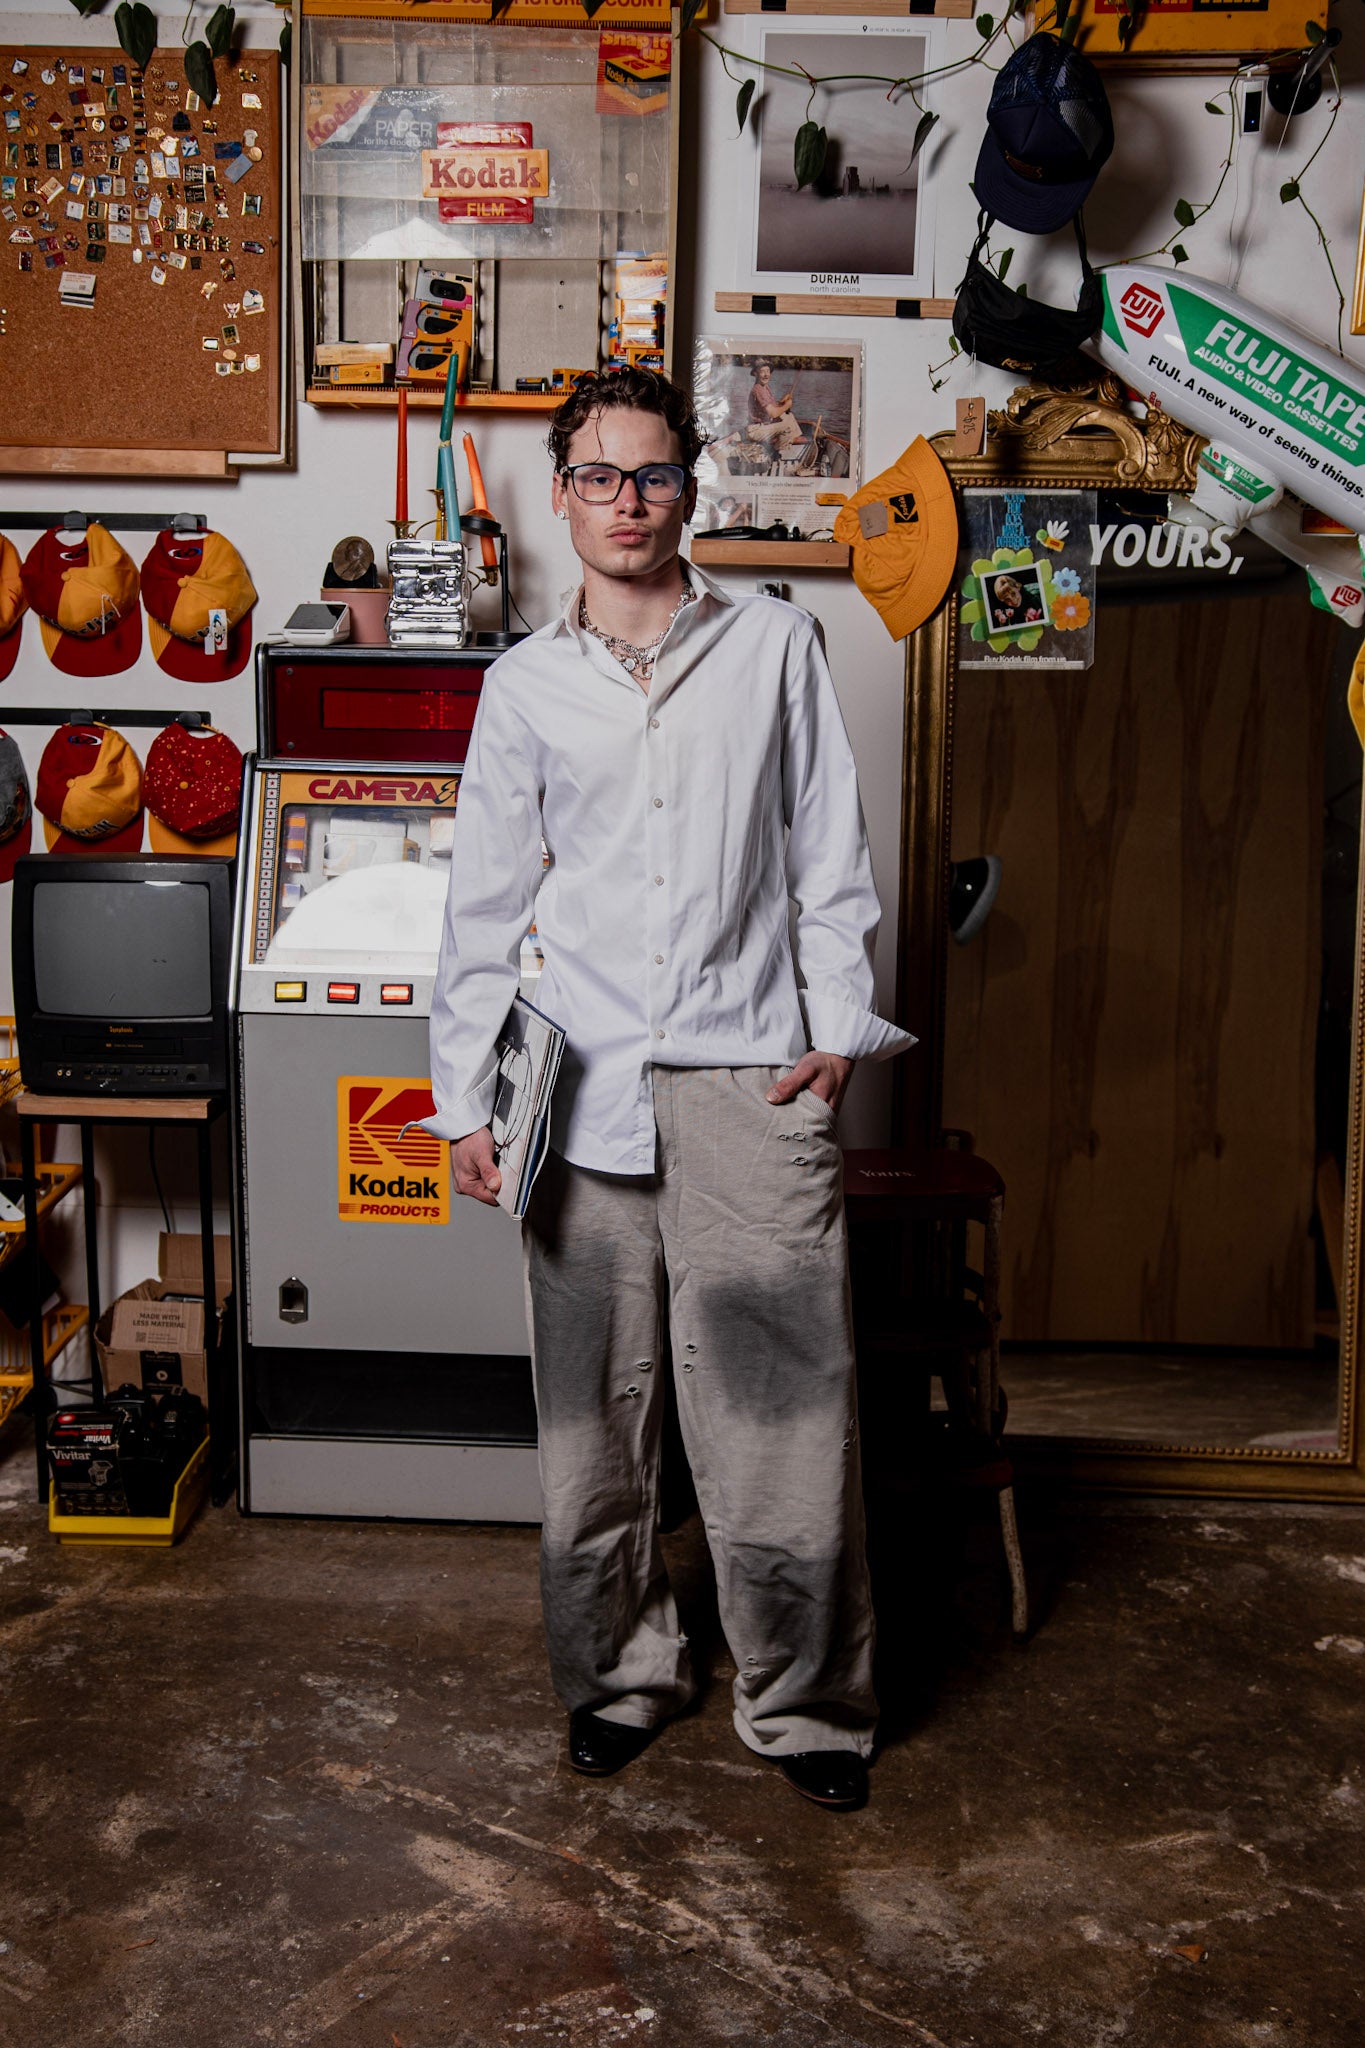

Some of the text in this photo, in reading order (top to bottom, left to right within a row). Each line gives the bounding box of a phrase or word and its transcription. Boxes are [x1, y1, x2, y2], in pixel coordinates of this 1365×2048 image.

[642, 48, 668, 63] up
[306, 89, 367, 146] Kodak
[375, 120, 433, 138] PAPER
[375, 137, 388, 145] the
[429, 157, 542, 188] Kodak
[466, 202, 505, 217] FILM
[810, 274, 860, 285] DURHAM
[810, 285, 861, 294] north carolina
[1120, 282, 1165, 332] FUJI
[1204, 319, 1365, 438] FUJI TAPE
[1194, 346, 1238, 376] AUDIO
[1244, 374, 1284, 405] VIDEO
[1283, 398, 1360, 452] CASSETTES
[1147, 354, 1365, 499] FUJI. A new way of seeing things.
[1240, 469, 1257, 483] TAPE
[1089, 524, 1245, 575] YOURS,
[999, 656, 1023, 664] Kodak
[1023, 656, 1038, 664] film
[1038, 656, 1056, 664] from
[308, 779, 439, 802] CAMERA
[349, 1173, 440, 1199] Kodak
[360, 1204, 440, 1217] PRODUCTS
[139, 1313, 181, 1321] MADE WITH
[52, 1450, 92, 1460] Vivitar
